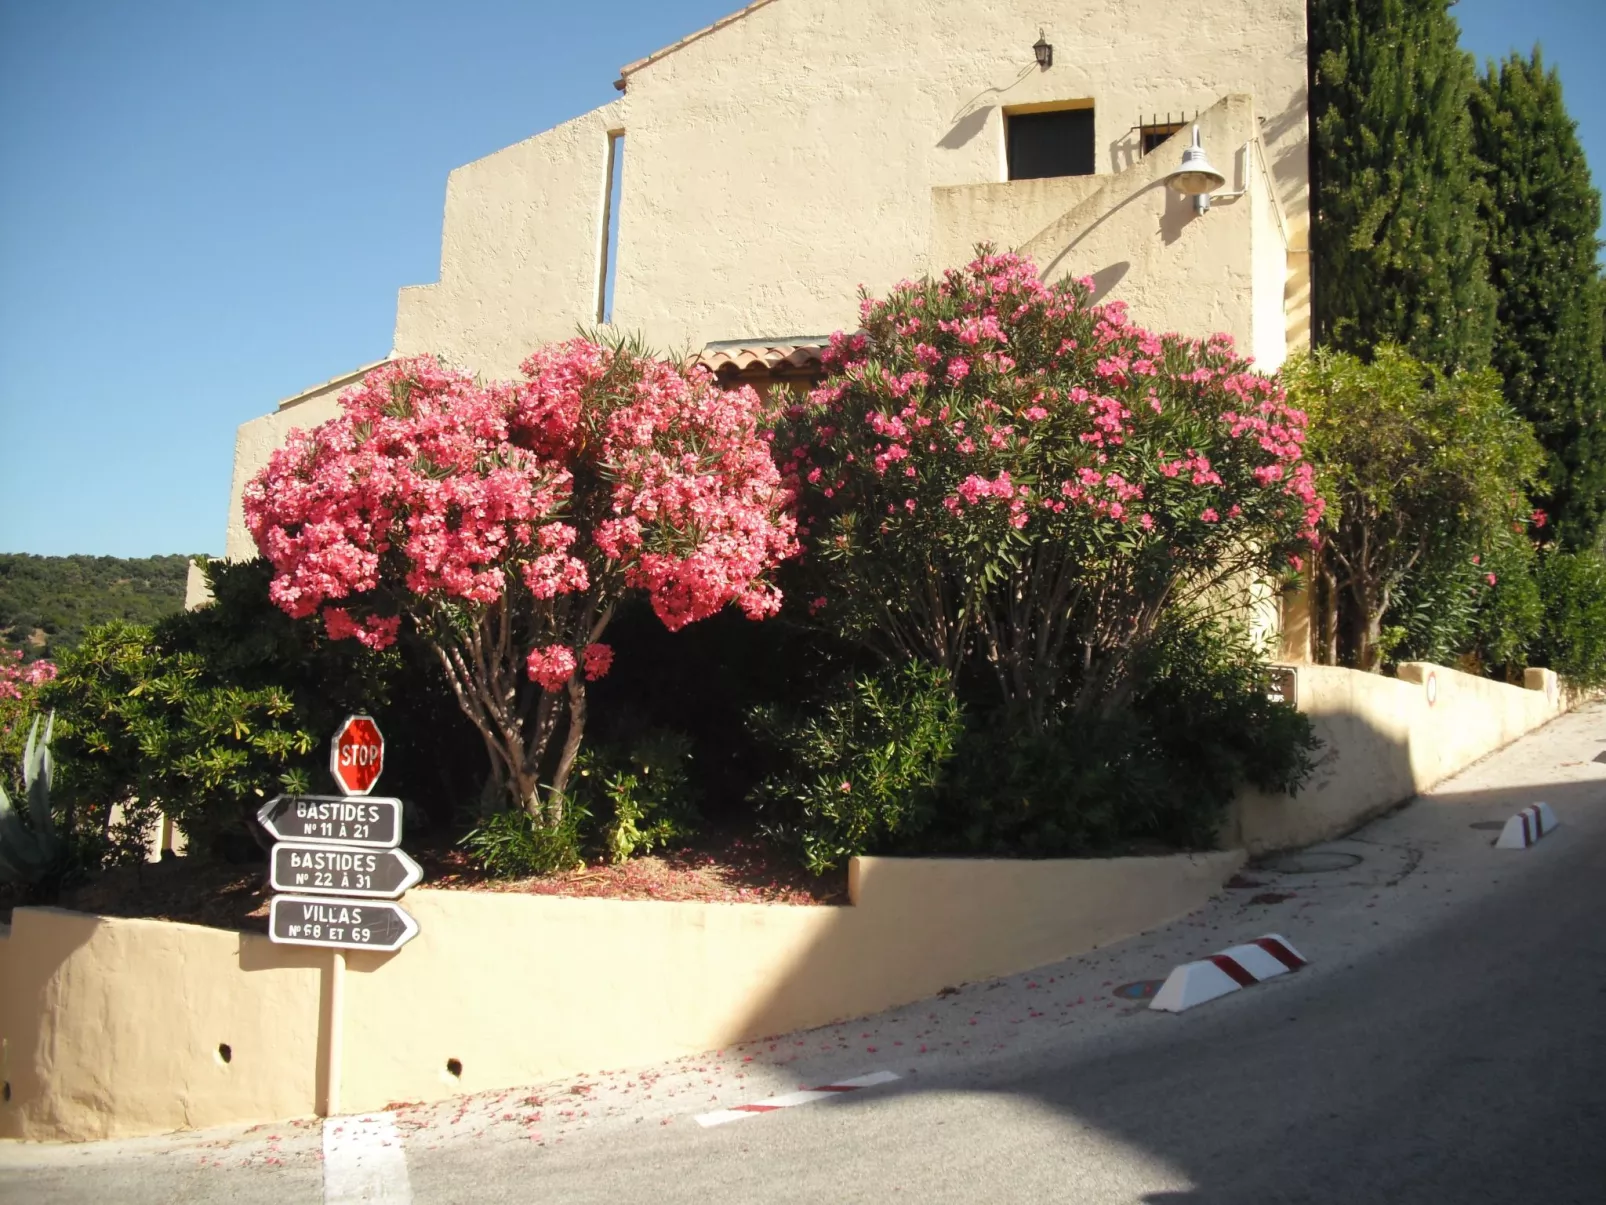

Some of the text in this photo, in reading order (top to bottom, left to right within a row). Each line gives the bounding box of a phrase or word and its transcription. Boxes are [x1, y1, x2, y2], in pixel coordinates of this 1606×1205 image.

[341, 744, 379, 766] STOP
[297, 802, 380, 822] BASTIDES
[320, 823, 332, 836] 11
[339, 823, 347, 837] À
[354, 825, 369, 838] 21
[291, 853, 376, 872] BASTIDES
[314, 873, 333, 886] 22
[341, 873, 349, 887] À
[356, 875, 371, 888] 31
[303, 905, 362, 924] VILLAS
[329, 928, 344, 940] ET
[352, 928, 370, 942] 69
